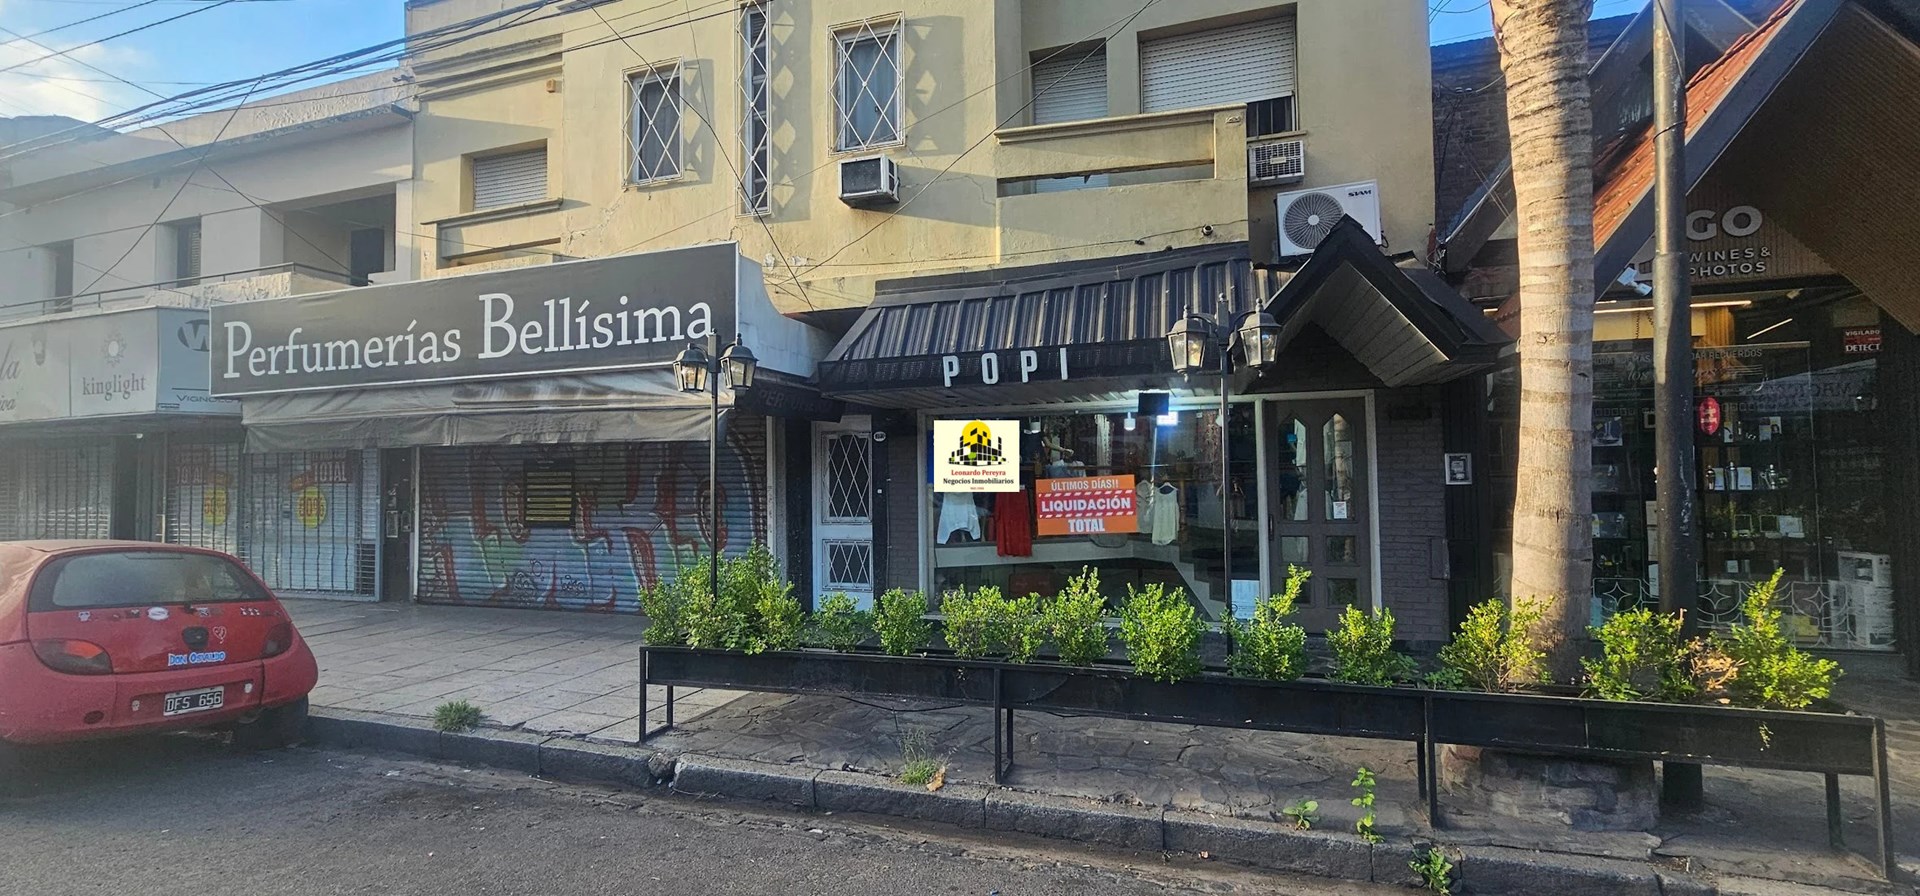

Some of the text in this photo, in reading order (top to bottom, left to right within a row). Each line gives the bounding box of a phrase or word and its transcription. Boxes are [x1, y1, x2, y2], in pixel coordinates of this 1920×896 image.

[1686, 205, 1763, 241] GO
[1760, 246, 1771, 257] &
[224, 293, 713, 378] Perfumerías Bellísima
[1708, 348, 1763, 360] RECUERDOS
[1845, 343, 1880, 352] DETECT
[943, 348, 1068, 387] POPI
[82, 373, 146, 401] kinglight
[313, 461, 347, 482] TOTAL
[1051, 476, 1119, 491] ÚLTIMOS DÍAS!!
[1041, 495, 1131, 513] LIQUIDACIÓN
[1068, 518, 1105, 533] TOTAL
[166, 692, 222, 711] DFS 656
